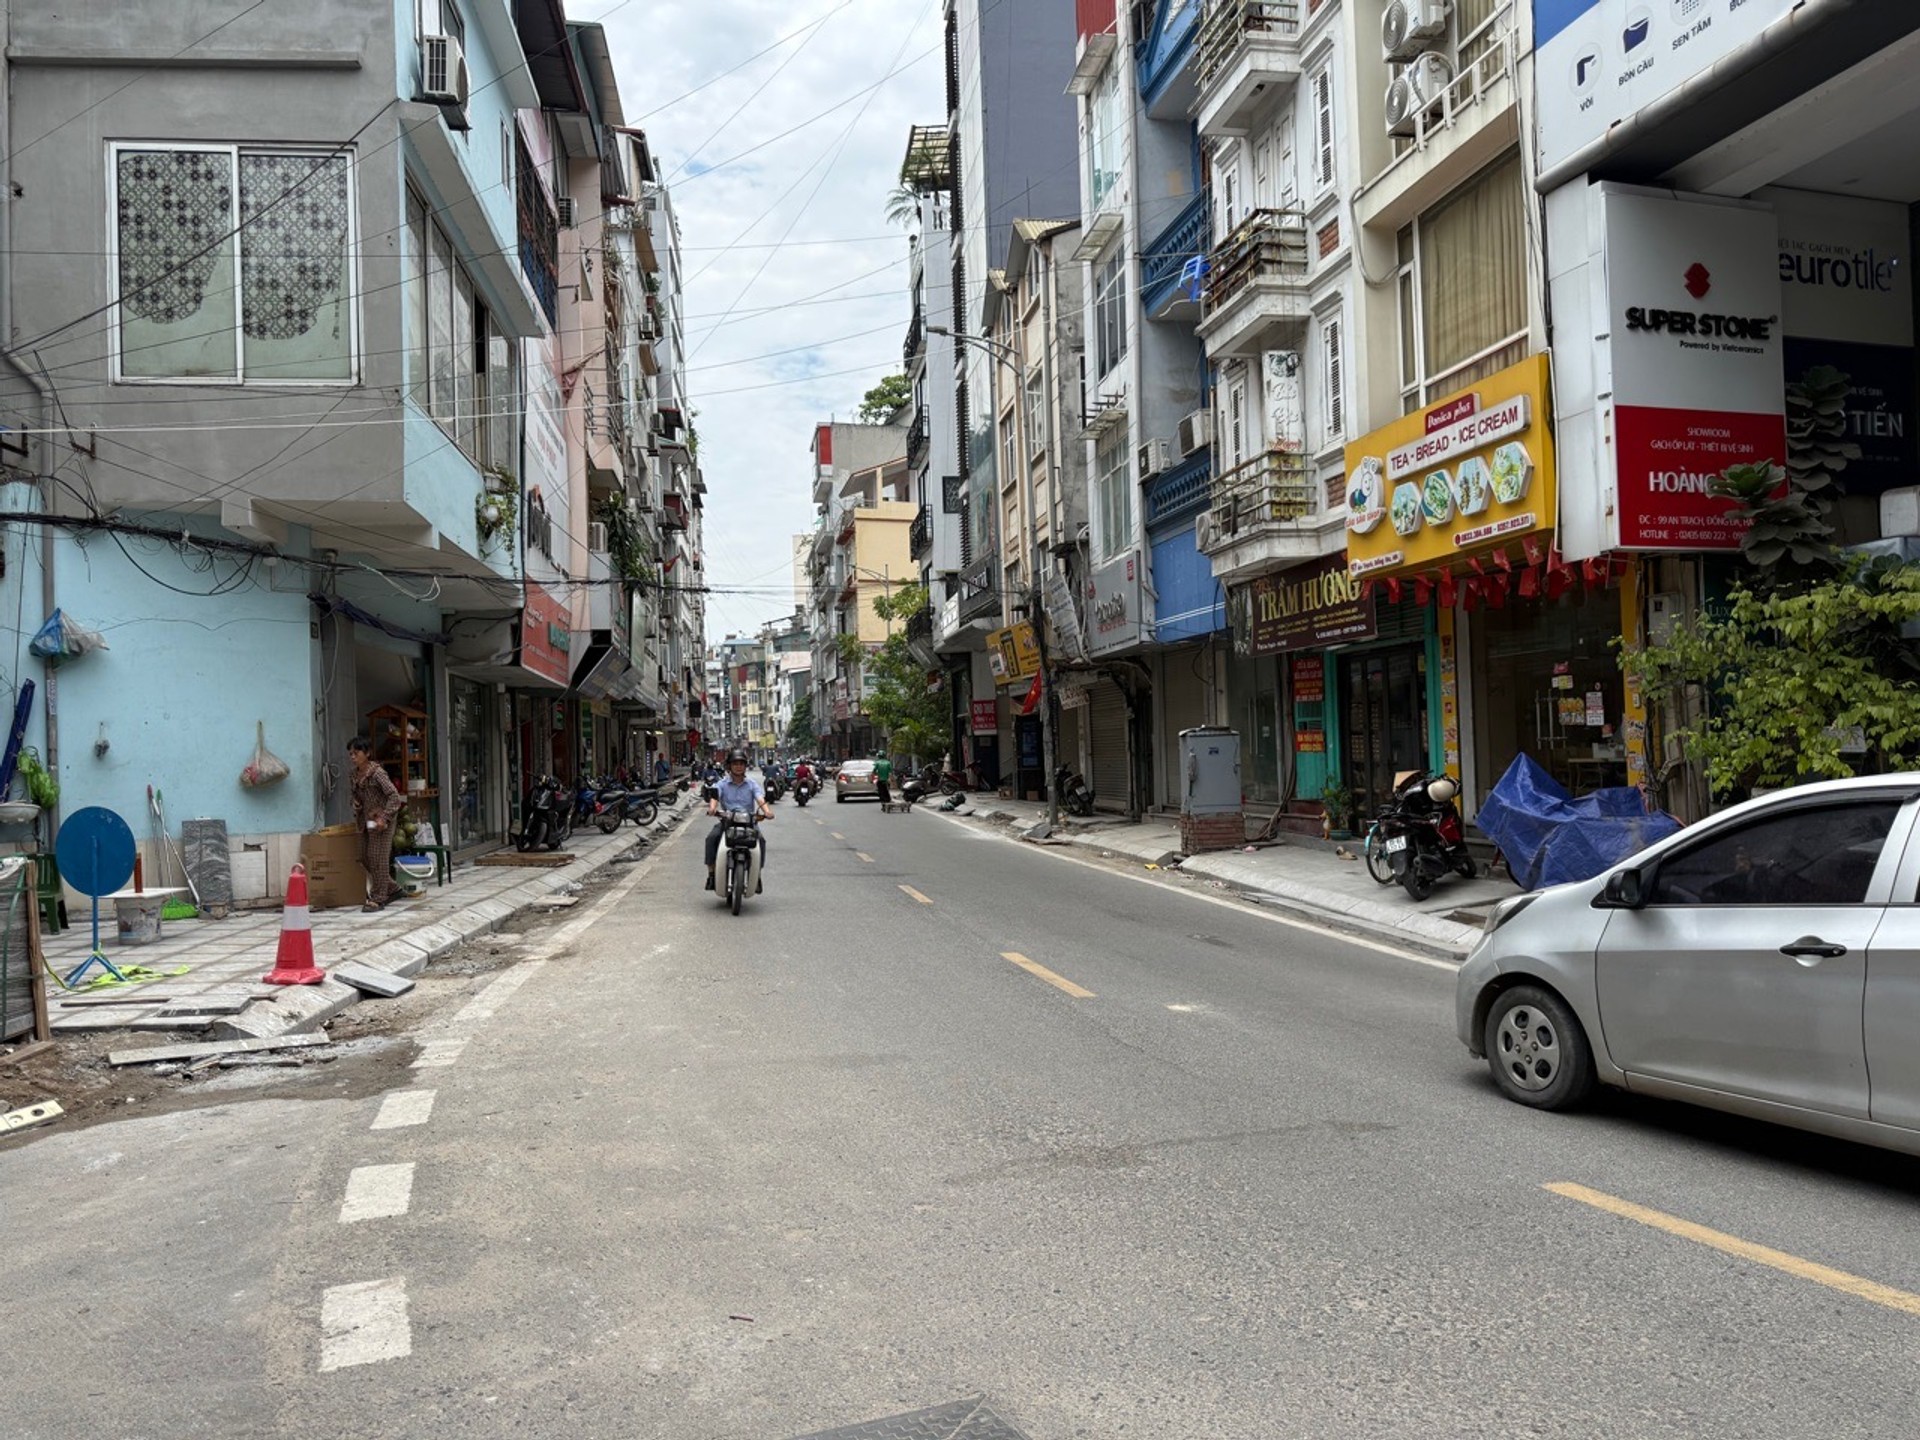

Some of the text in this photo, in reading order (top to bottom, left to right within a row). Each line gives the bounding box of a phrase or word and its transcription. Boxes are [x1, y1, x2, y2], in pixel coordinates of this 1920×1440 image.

[1672, 32, 1689, 50] SEN
[1618, 57, 1654, 86] BỒN CẦU
[1579, 97, 1593, 112] VÒI
[1680, 341, 1709, 351] Powered
[1711, 342, 1720, 352] by
[1851, 401, 1904, 438] TIẾN
[1390, 450, 1409, 471] TEA
[1416, 435, 1449, 462] BREAD
[1458, 425, 1476, 444] ICE
[1477, 405, 1518, 436] CREAM
[1687, 426, 1731, 438] SHOWROOM
[1738, 444, 1754, 453] SINH
[1657, 515, 1668, 525] 99
[1668, 516, 1679, 525] AN
[1639, 529, 1670, 540] HOTLINE
[1258, 576, 1300, 623] TRẦM
[1301, 567, 1363, 612] HƯƠNG
